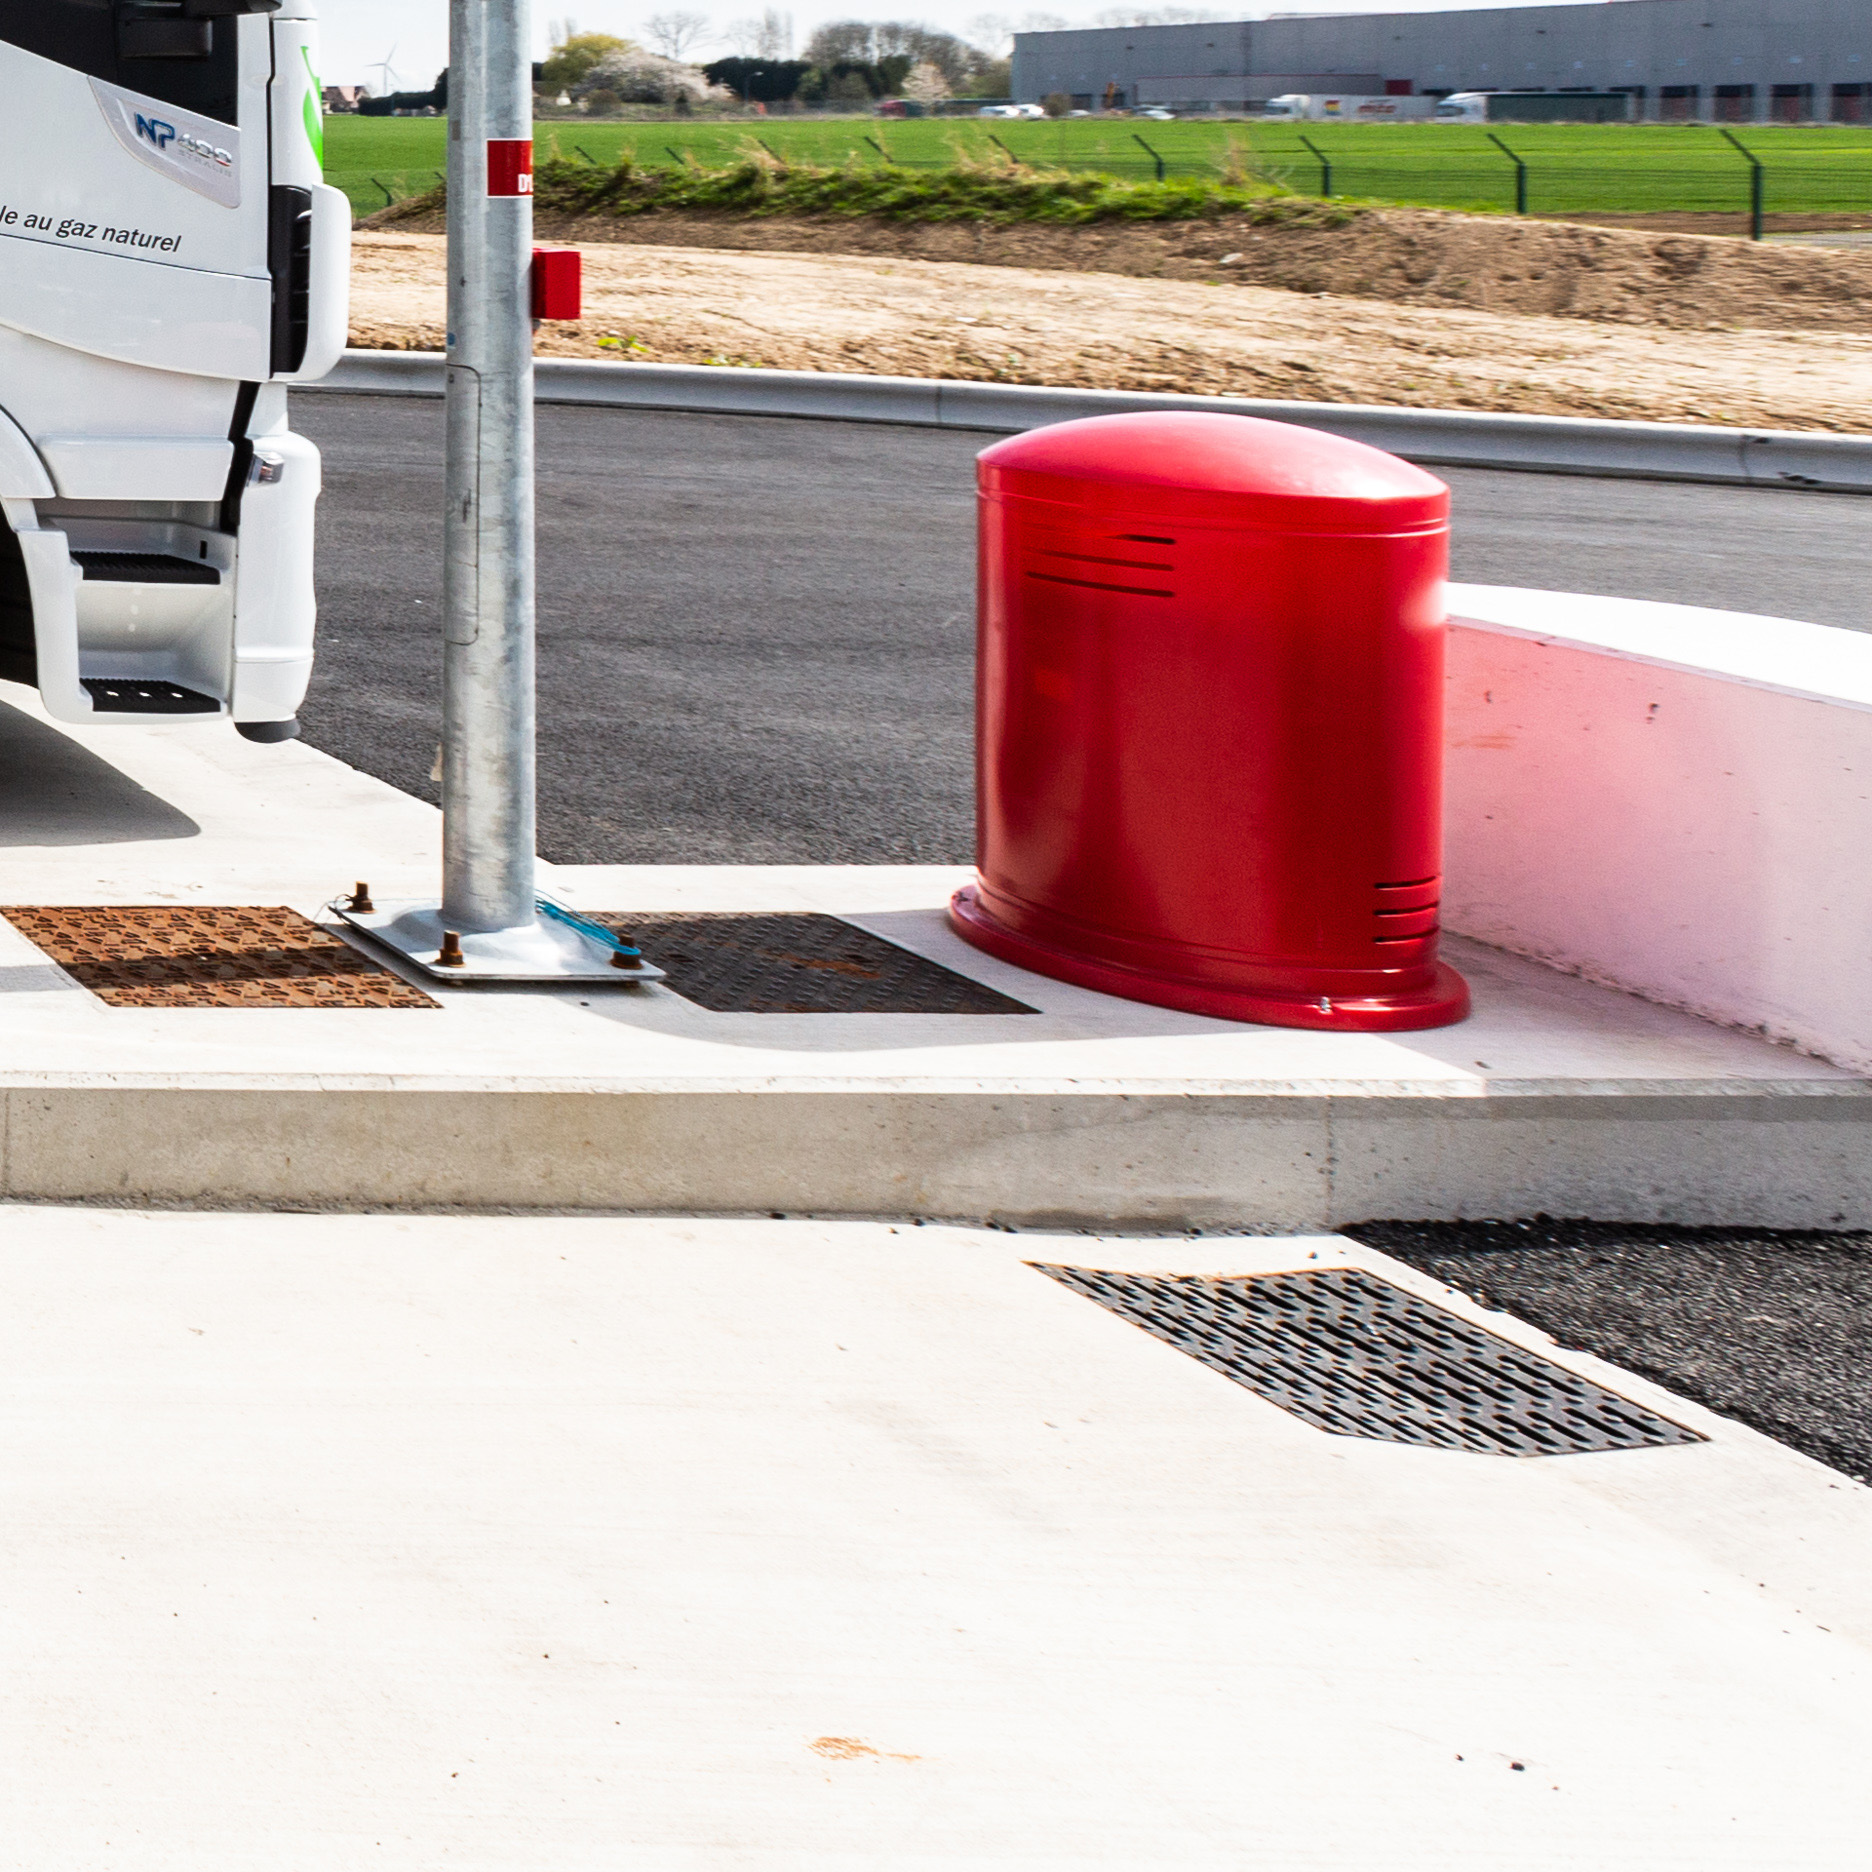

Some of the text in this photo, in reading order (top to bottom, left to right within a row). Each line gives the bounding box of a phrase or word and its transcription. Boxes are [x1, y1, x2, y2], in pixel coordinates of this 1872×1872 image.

[134, 113, 176, 151] NP
[24, 214, 53, 231] au
[56, 219, 98, 239] gaz
[102, 227, 182, 253] naturel
